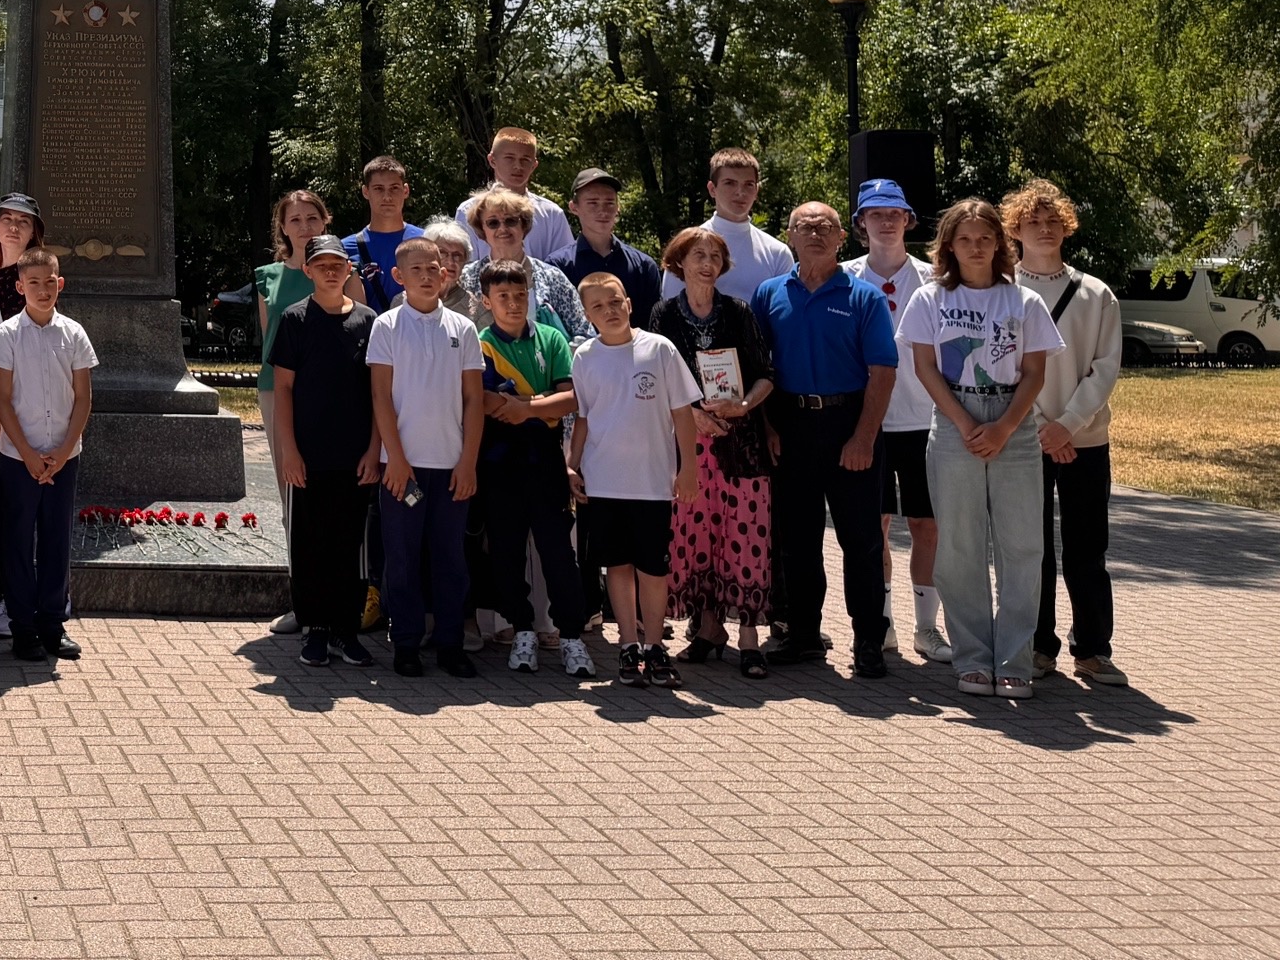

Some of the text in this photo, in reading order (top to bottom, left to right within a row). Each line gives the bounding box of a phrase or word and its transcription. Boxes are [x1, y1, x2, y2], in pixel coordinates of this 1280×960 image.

[46, 32, 144, 43] УКАЗ ПРЕЗИДИУМА
[61, 67, 125, 77] ХРЮКИНА
[89, 77, 141, 85] ТИМОФЕЕВИЧА
[939, 308, 987, 324] ХОЧУ
